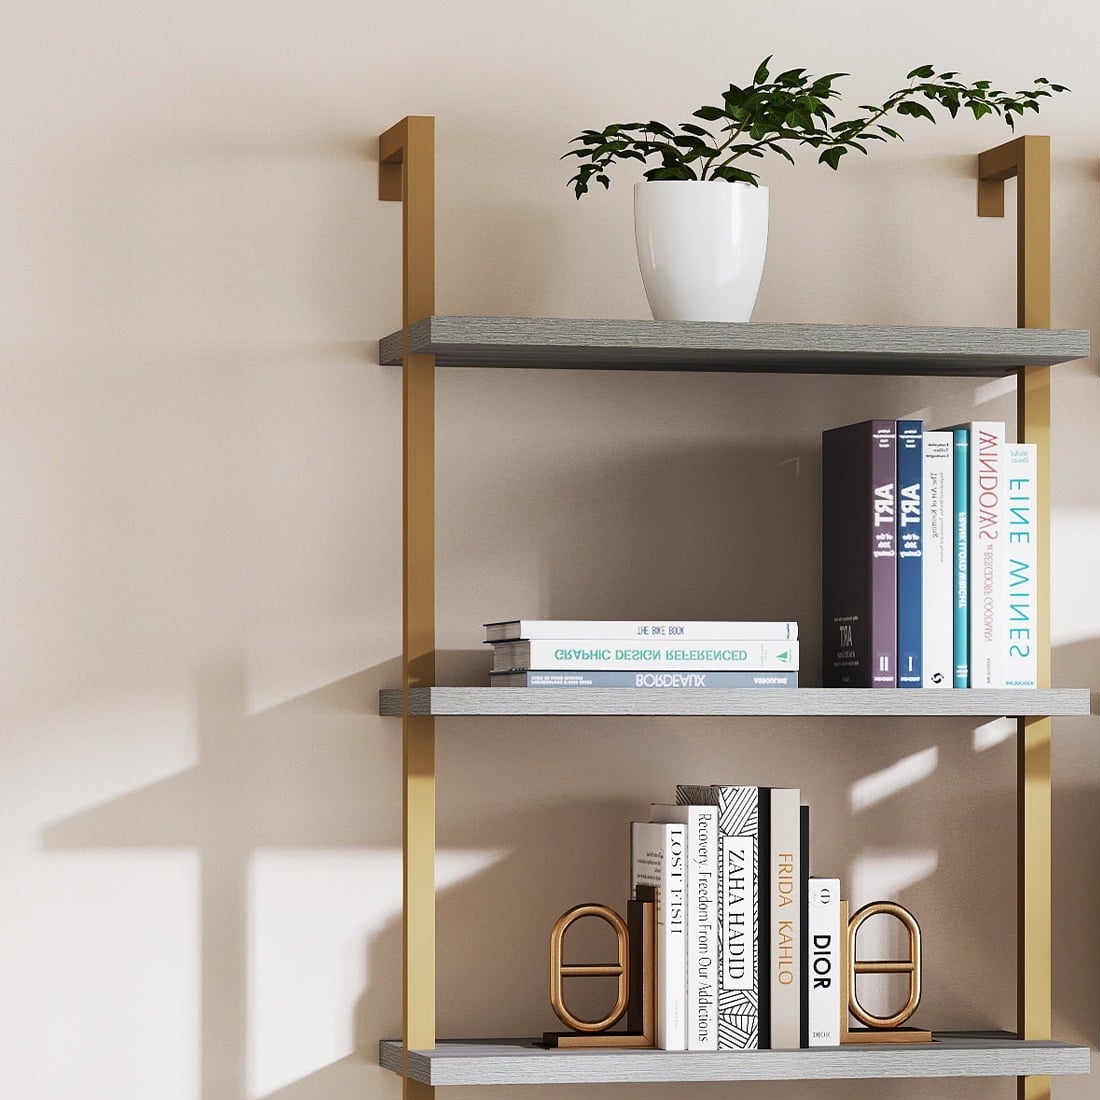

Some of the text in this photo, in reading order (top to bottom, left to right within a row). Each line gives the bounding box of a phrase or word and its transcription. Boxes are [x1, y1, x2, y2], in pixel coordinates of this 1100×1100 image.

[670, 830, 682, 935] LOST FISH
[698, 872, 712, 921] Freedom
[698, 924, 712, 954] From
[728, 849, 745, 979] ZAHA HADID
[778, 852, 793, 985] FRIDA KAHLO
[698, 957, 712, 979] Our
[813, 934, 831, 990] DIOR
[698, 982, 712, 1042] Addictions
